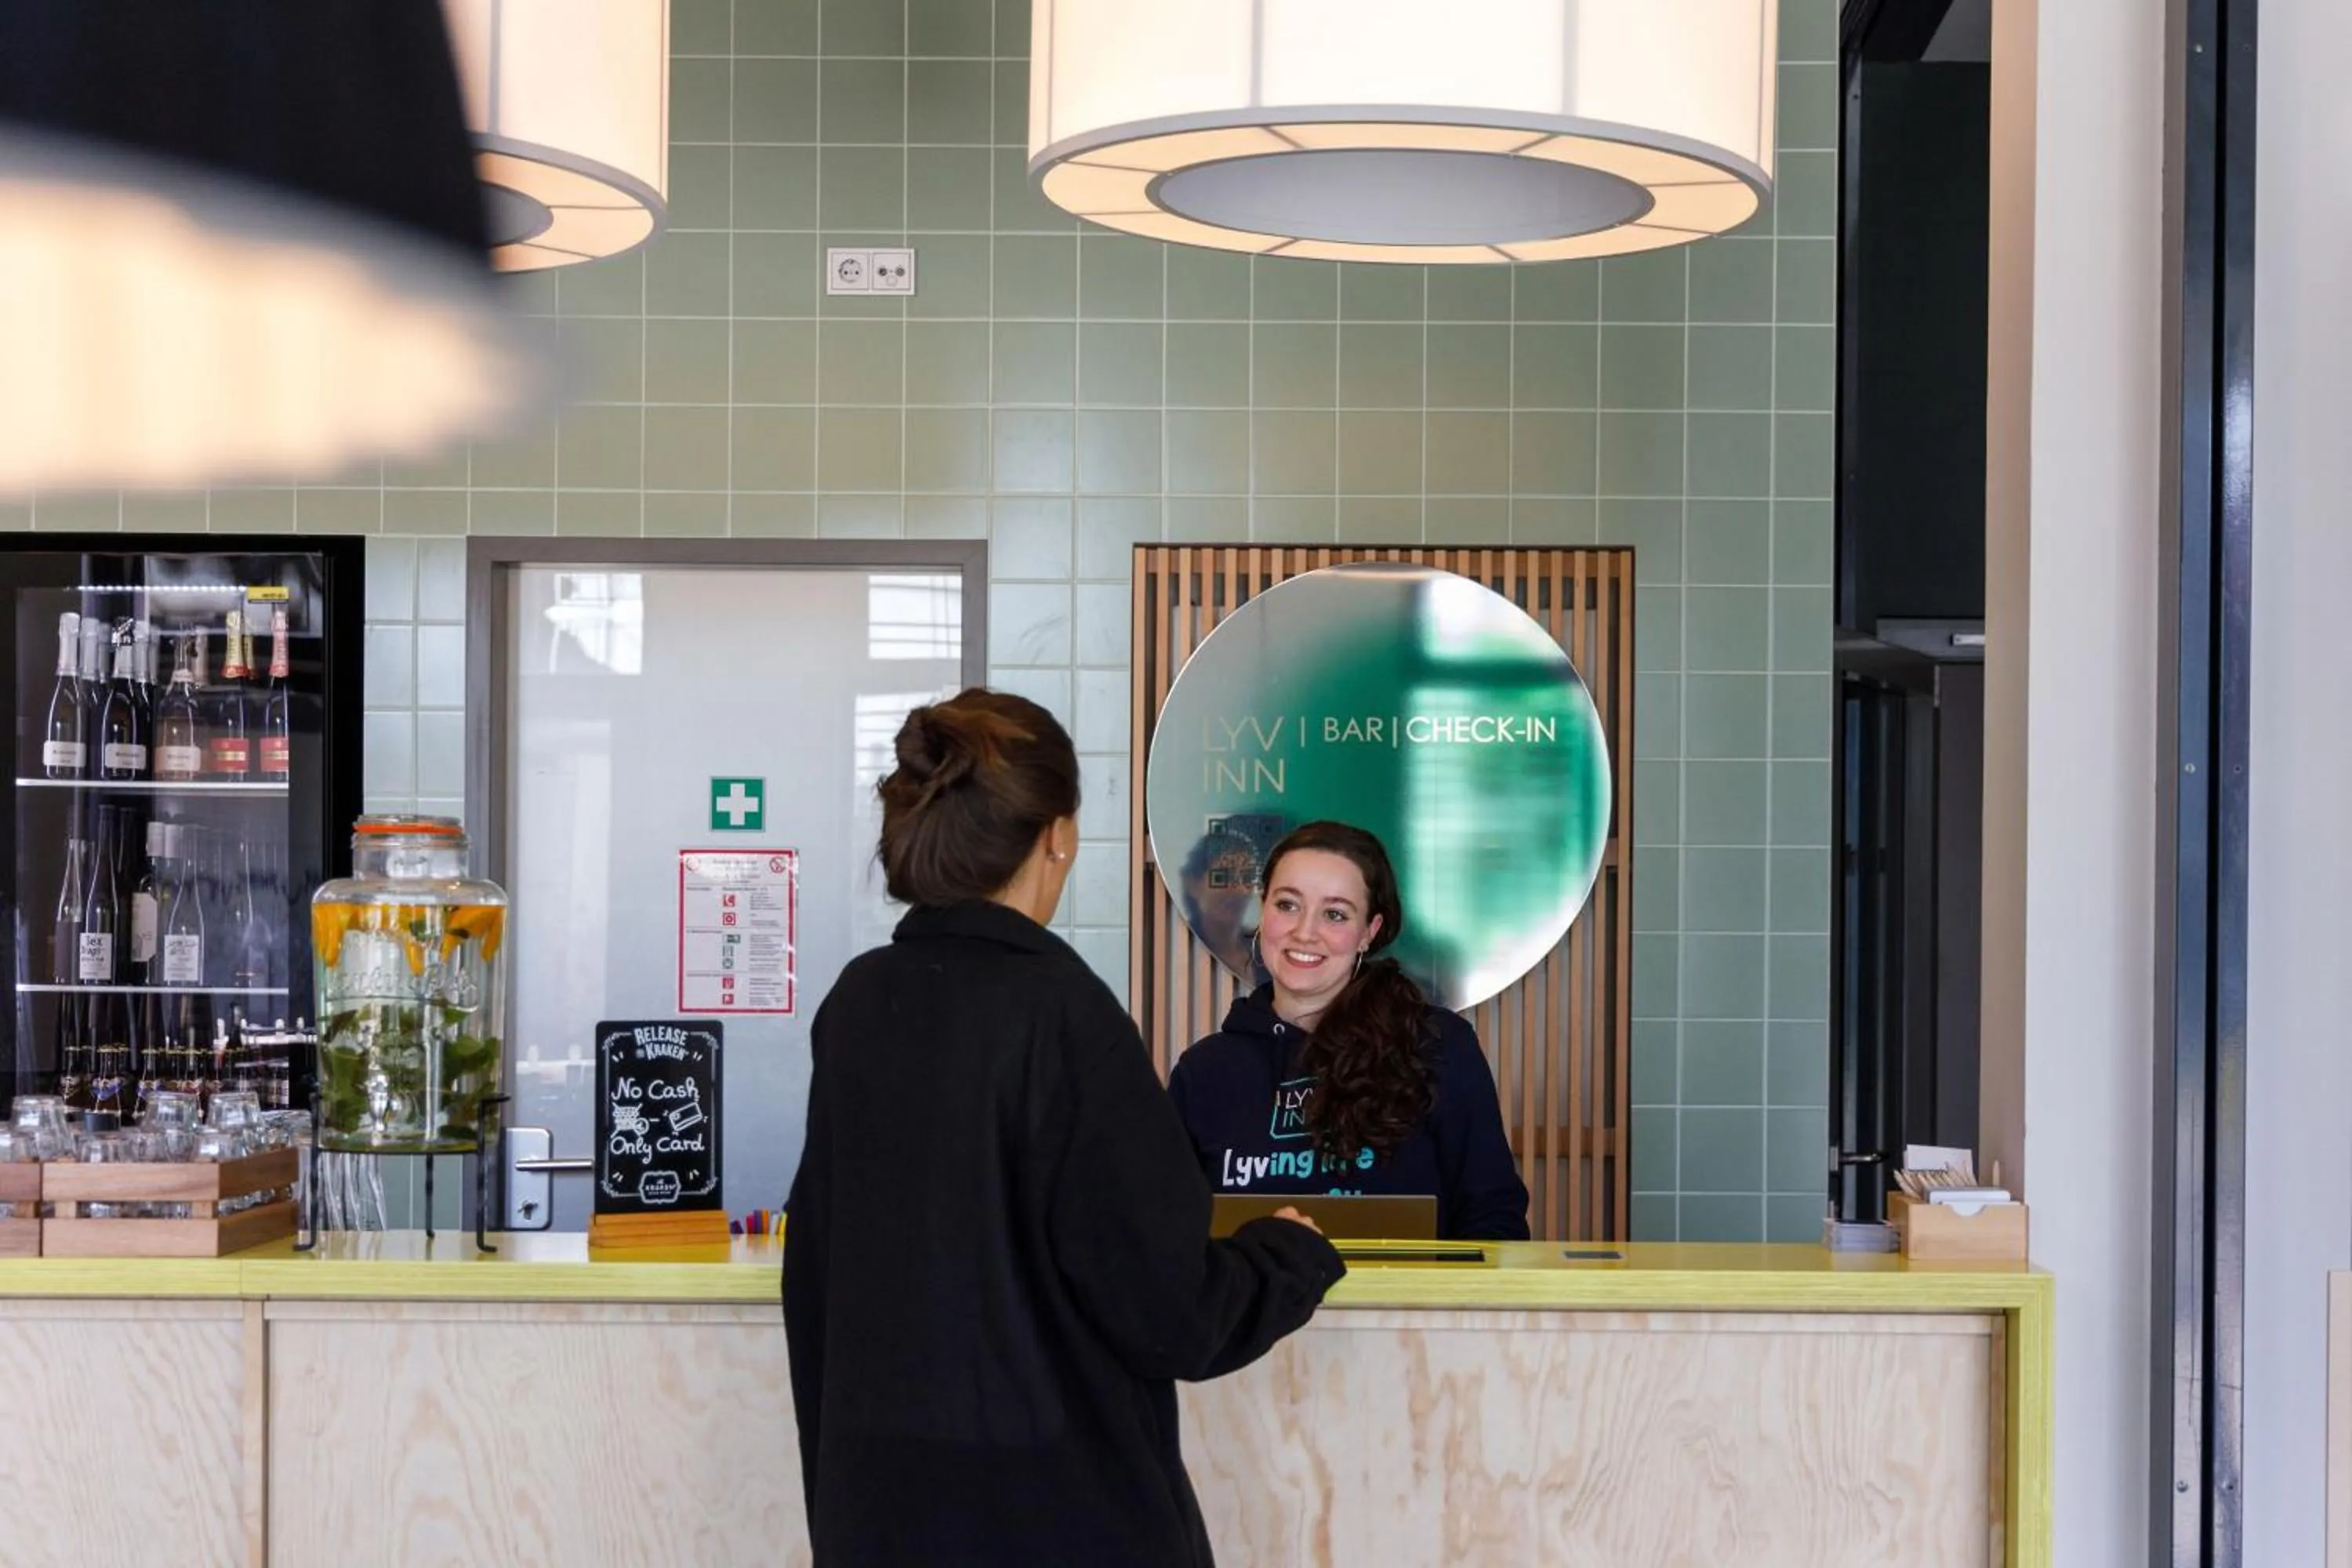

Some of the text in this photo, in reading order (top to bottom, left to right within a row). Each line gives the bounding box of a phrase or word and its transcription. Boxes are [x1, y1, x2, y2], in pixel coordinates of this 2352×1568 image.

[1203, 716, 1556, 751] LYV BAR CHECK-IN
[1203, 758, 1285, 793] INN
[633, 1025, 689, 1047] RELEASE
[611, 1076, 700, 1101] No Cash
[611, 1133, 705, 1164] Only Card
[1222, 1148, 1315, 1186] Lyving
